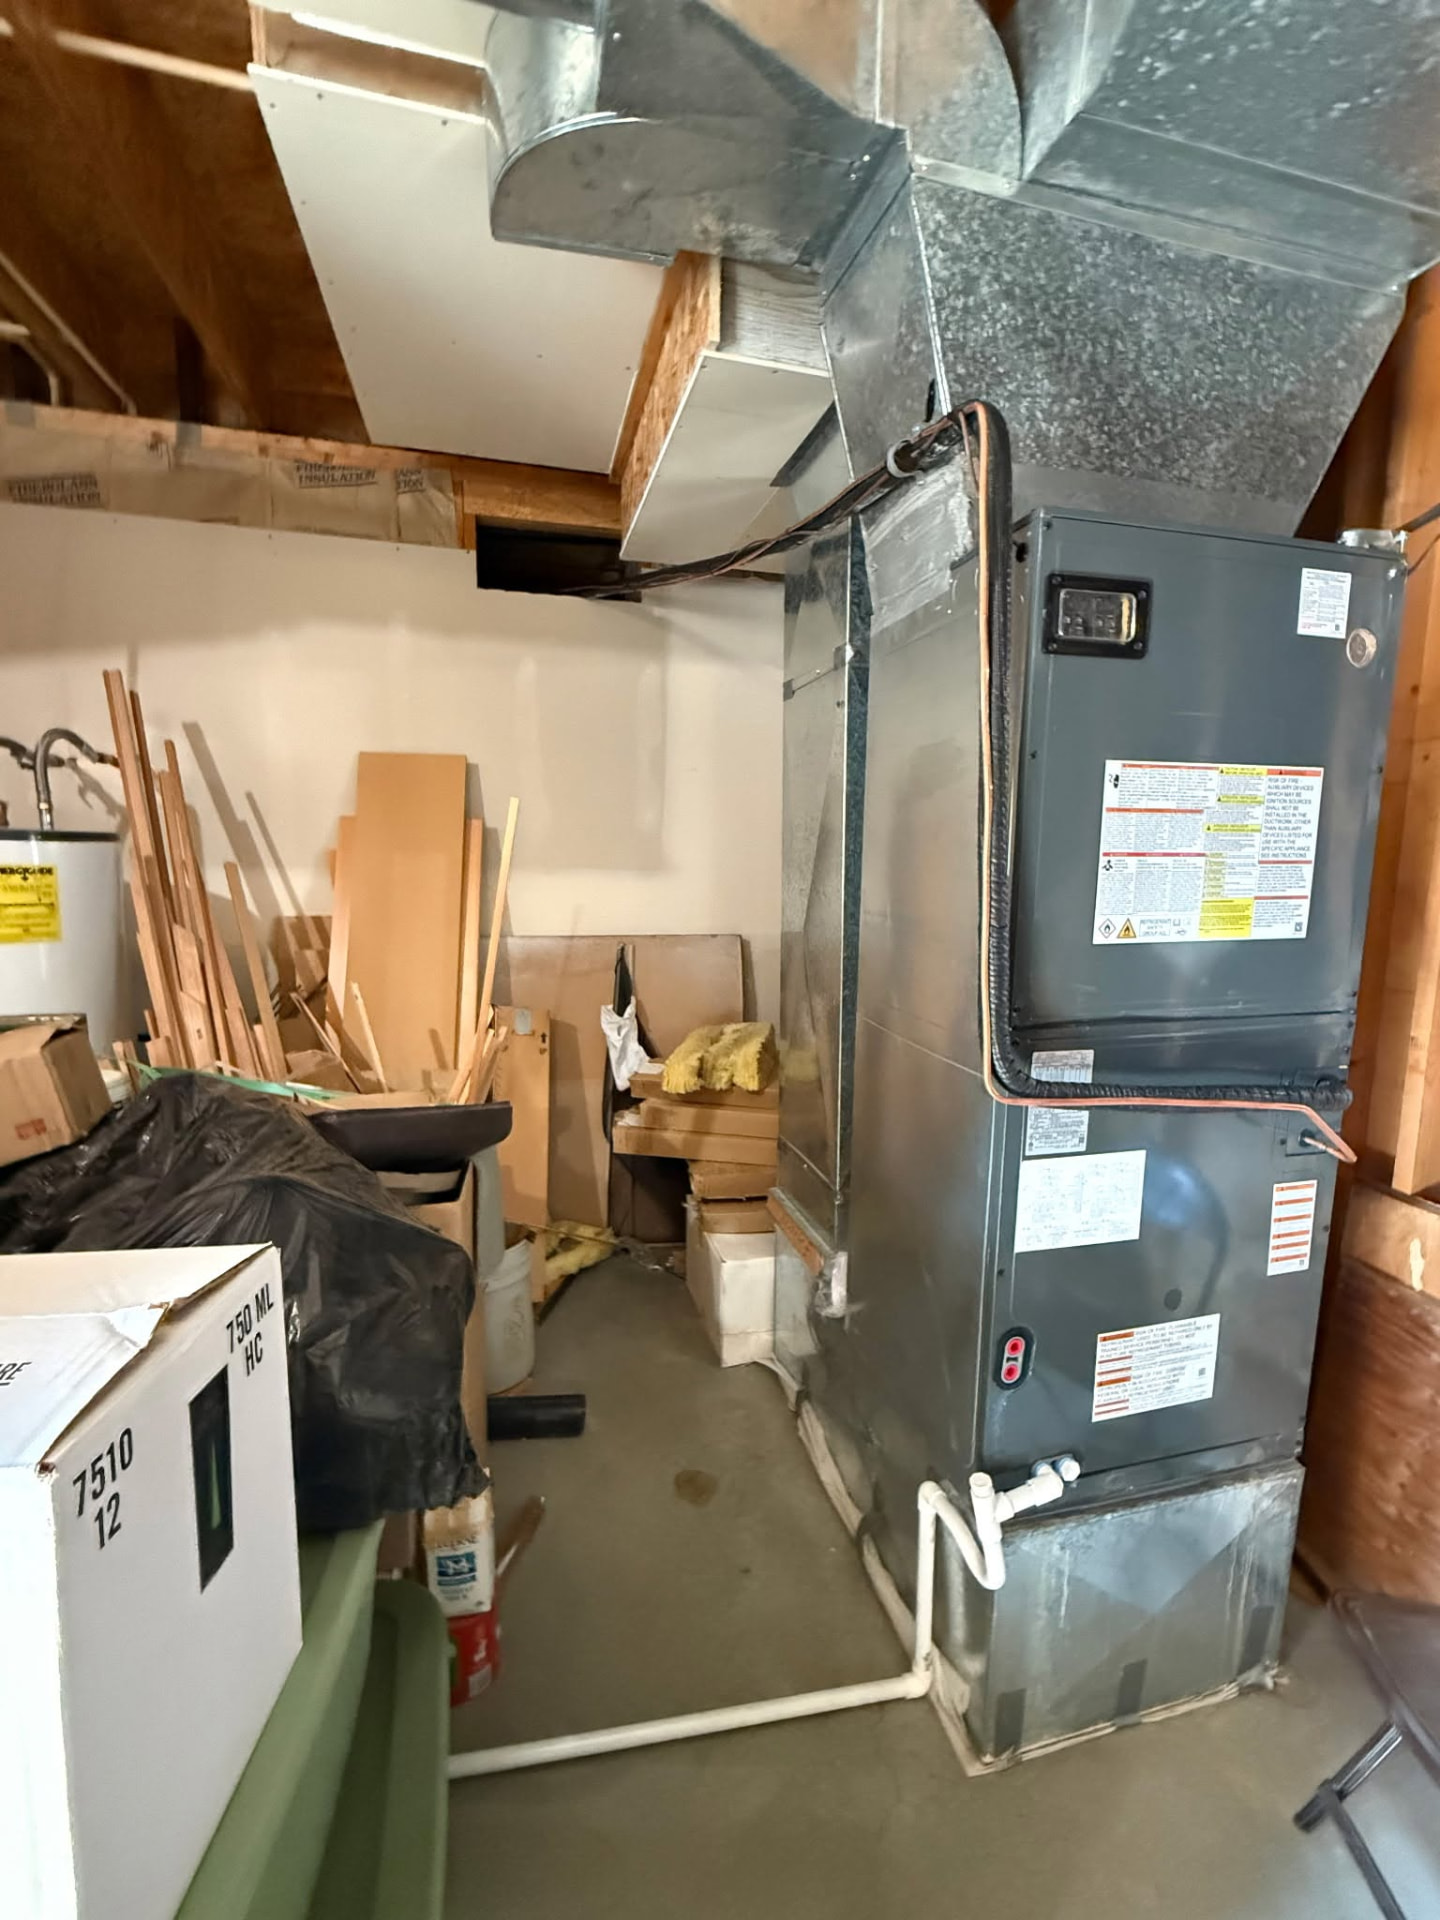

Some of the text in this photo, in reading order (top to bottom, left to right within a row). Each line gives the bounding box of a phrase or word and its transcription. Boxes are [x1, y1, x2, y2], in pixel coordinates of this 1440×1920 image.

[226, 1282, 274, 1354] 750 ML
[0, 1361, 32, 1380] RE
[245, 1331, 263, 1377] HC
[72, 1427, 133, 1518] 7510
[94, 1491, 122, 1550] 12
